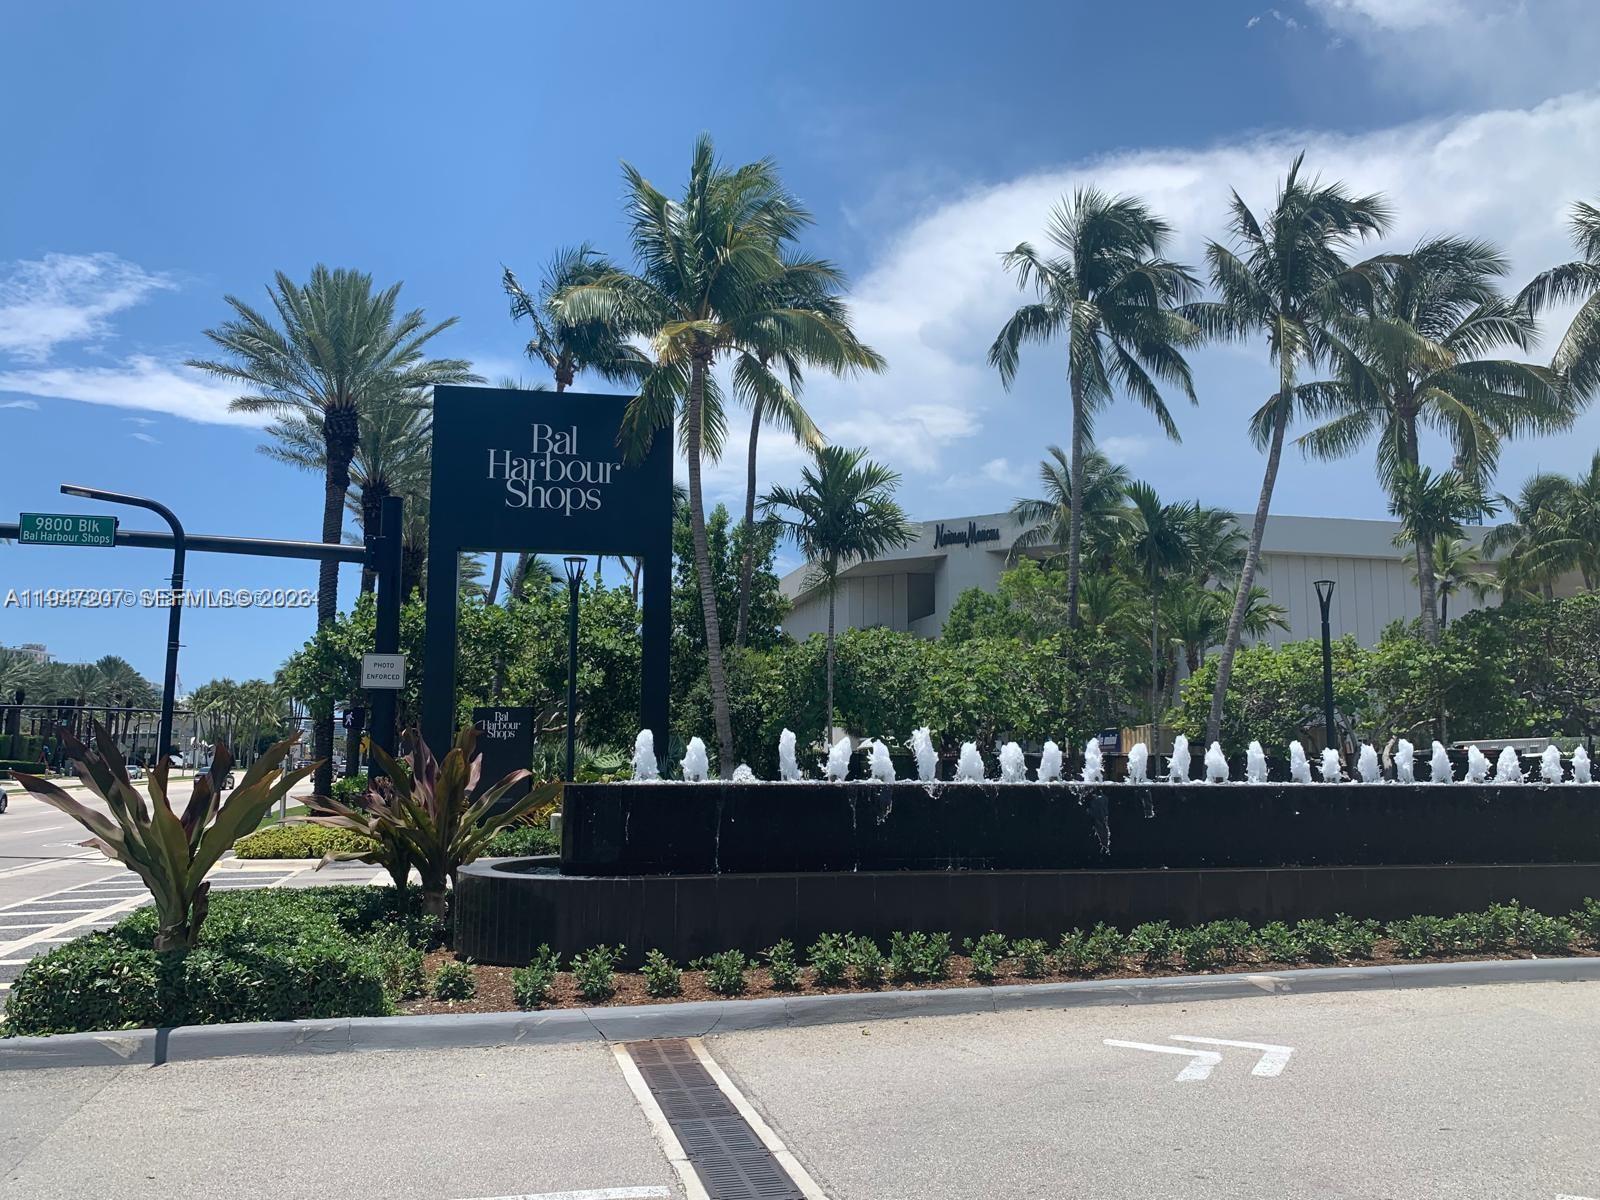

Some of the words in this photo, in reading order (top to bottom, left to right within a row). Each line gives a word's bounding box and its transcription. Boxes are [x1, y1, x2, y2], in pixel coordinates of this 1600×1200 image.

[531, 423, 580, 455] Bal
[486, 448, 622, 484] Harbour
[505, 478, 602, 516] Shops
[35, 517, 73, 532] 9800
[78, 519, 100, 533] Blk
[23, 530, 38, 541] Bal
[40, 531, 79, 543] Harbour
[81, 532, 110, 545] Shops
[494, 711, 509, 721] Bal
[482, 719, 521, 730] Harbour
[487, 729, 516, 740] Shops
